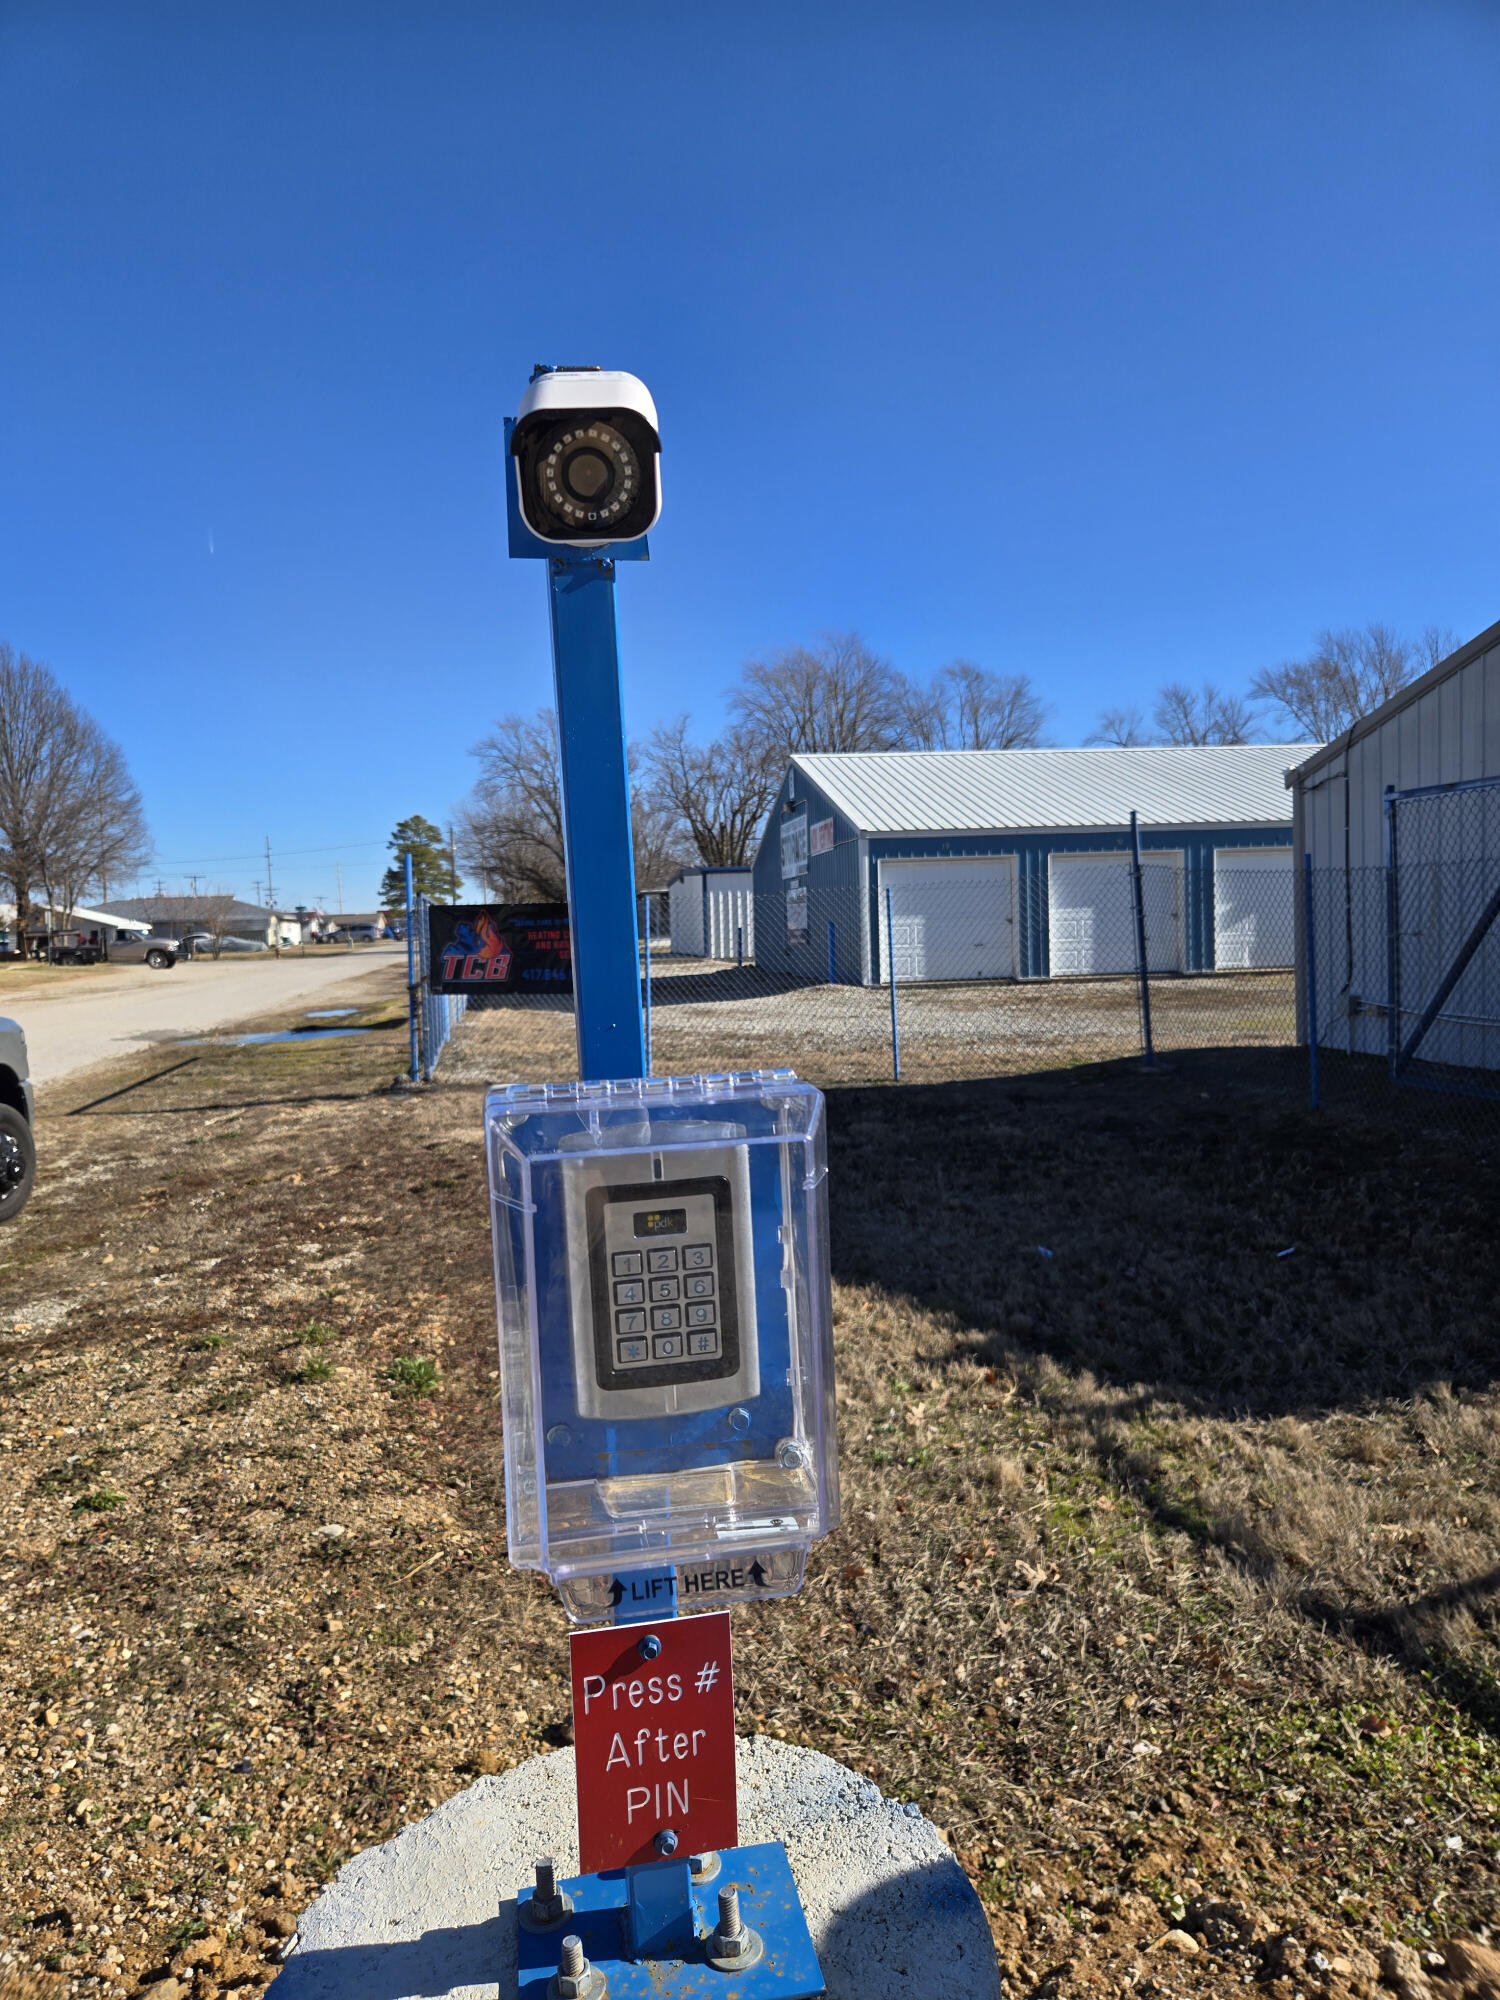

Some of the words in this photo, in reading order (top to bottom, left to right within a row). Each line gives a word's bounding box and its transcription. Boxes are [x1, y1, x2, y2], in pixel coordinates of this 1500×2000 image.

[443, 954, 512, 980] TCB
[654, 1215, 673, 1231] pdk
[624, 1257, 632, 1272] 1
[657, 1254, 670, 1270] 2
[693, 1251, 705, 1265] 3
[624, 1286, 636, 1301] 4
[659, 1283, 671, 1298] 5
[694, 1279, 706, 1294] 6
[626, 1315, 637, 1330] 7
[661, 1312, 673, 1327] 8
[695, 1308, 707, 1323] 9
[662, 1341, 674, 1355] 0
[697, 1336, 710, 1351] #
[632, 1577, 677, 1601] LIFT
[684, 1568, 745, 1594] HERE
[583, 1673, 683, 1715] Press
[694, 1661, 721, 1694] #
[606, 1728, 707, 1772] After
[627, 1778, 690, 1824] PIN
